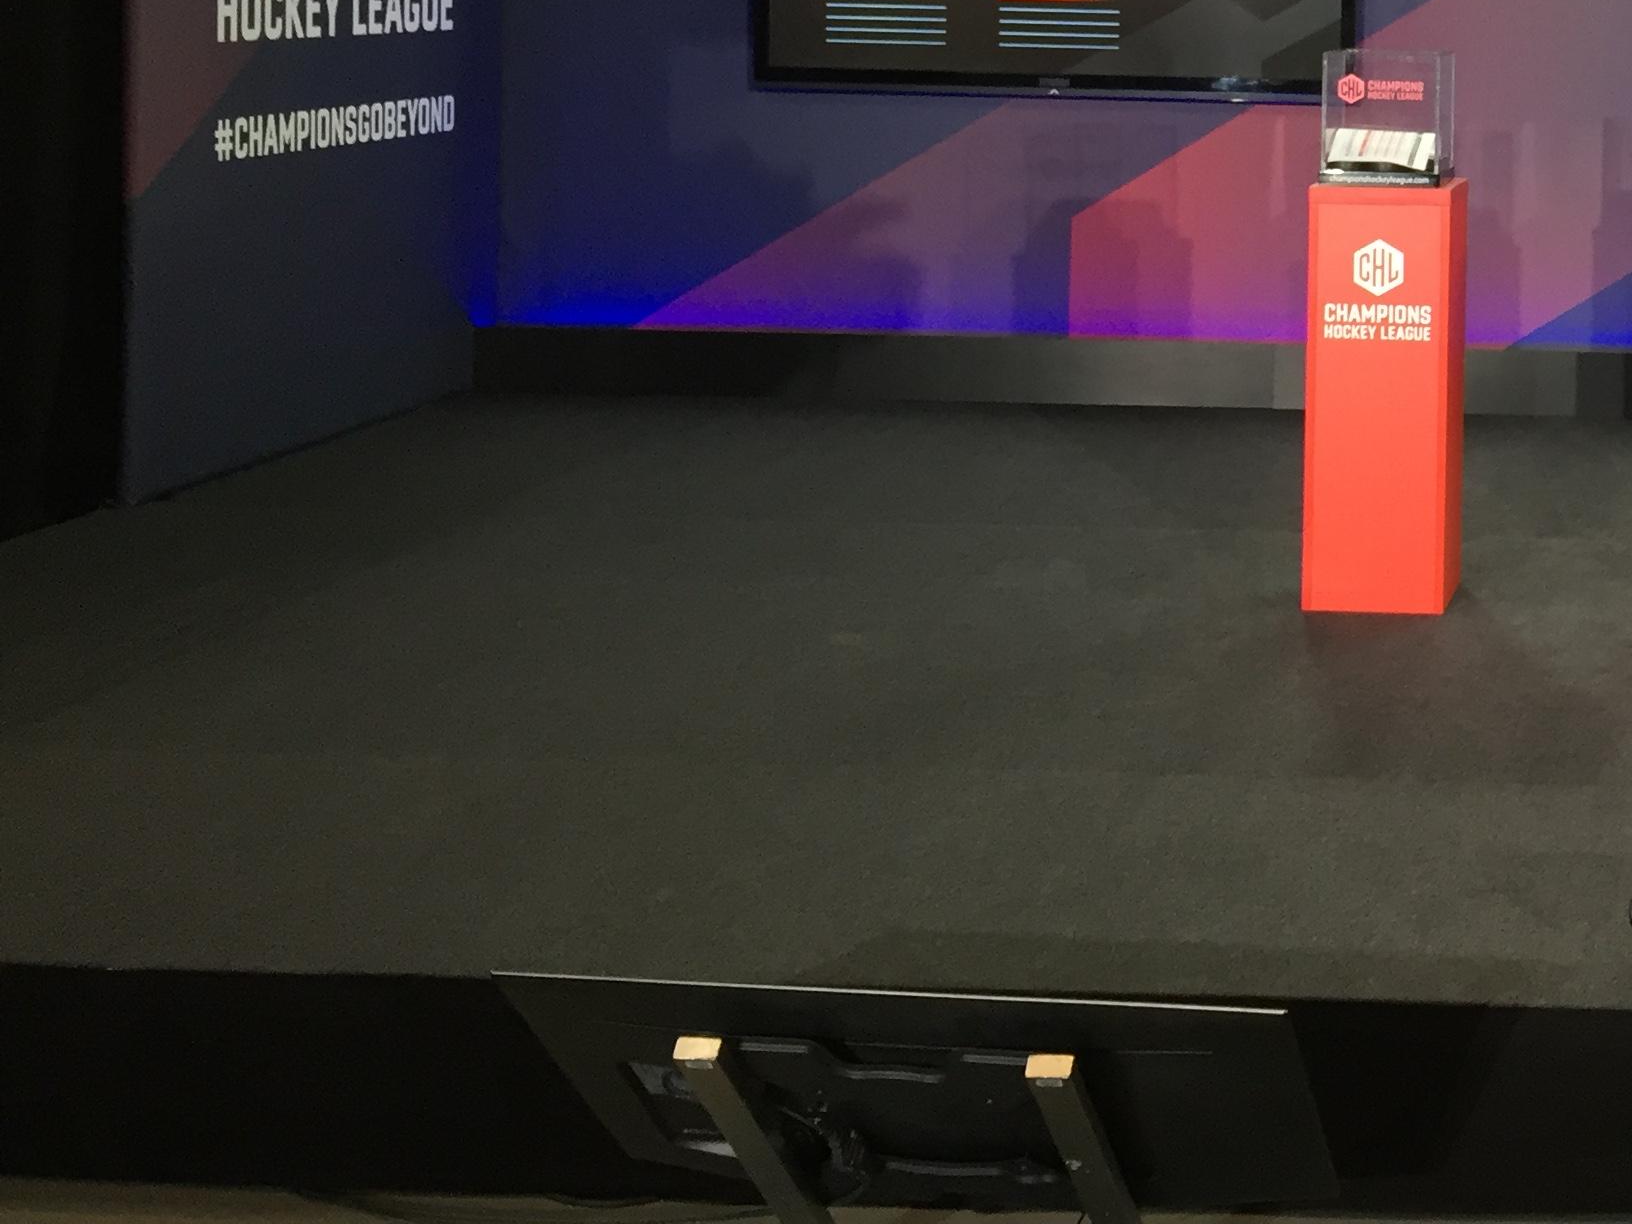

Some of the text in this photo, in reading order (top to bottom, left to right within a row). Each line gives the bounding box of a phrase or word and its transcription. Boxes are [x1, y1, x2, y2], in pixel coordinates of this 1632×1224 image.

[1340, 78, 1362, 100] CHL
[1367, 80, 1424, 93] CHAMPIONS
[214, 93, 456, 162] #CHAMPIONSGOBEYOND
[1359, 248, 1399, 287] CHL
[1324, 302, 1432, 325] CHAMPIONS
[1324, 324, 1431, 341] HOCKEY LEAGUE
